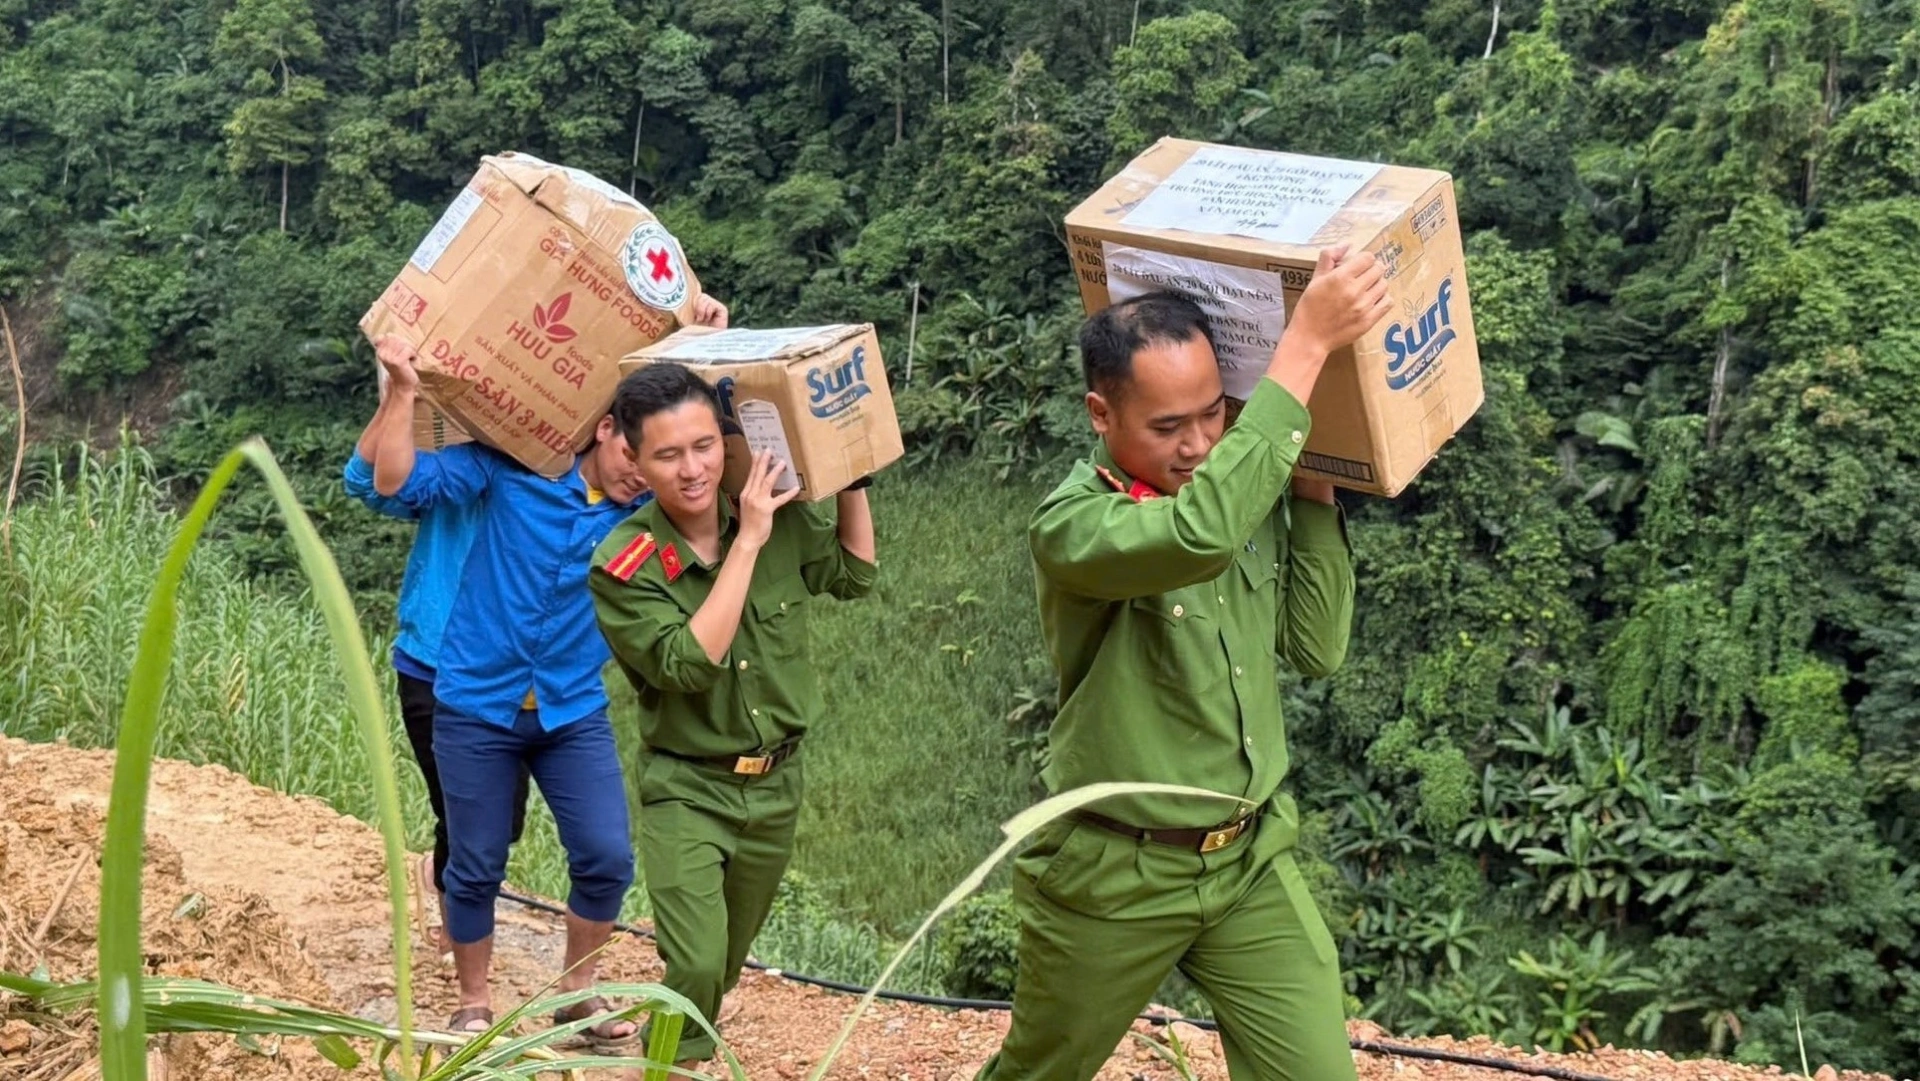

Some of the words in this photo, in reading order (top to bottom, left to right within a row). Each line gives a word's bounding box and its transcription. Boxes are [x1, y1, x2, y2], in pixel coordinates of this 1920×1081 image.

[610, 297, 660, 340] FOODS
[1384, 278, 1452, 372] Surf
[431, 338, 480, 382] ĐẶC
[474, 376, 524, 415] SẢN
[516, 408, 535, 427] 3
[552, 357, 587, 392] GIA
[566, 345, 595, 372] foods
[807, 345, 865, 403] Surf
